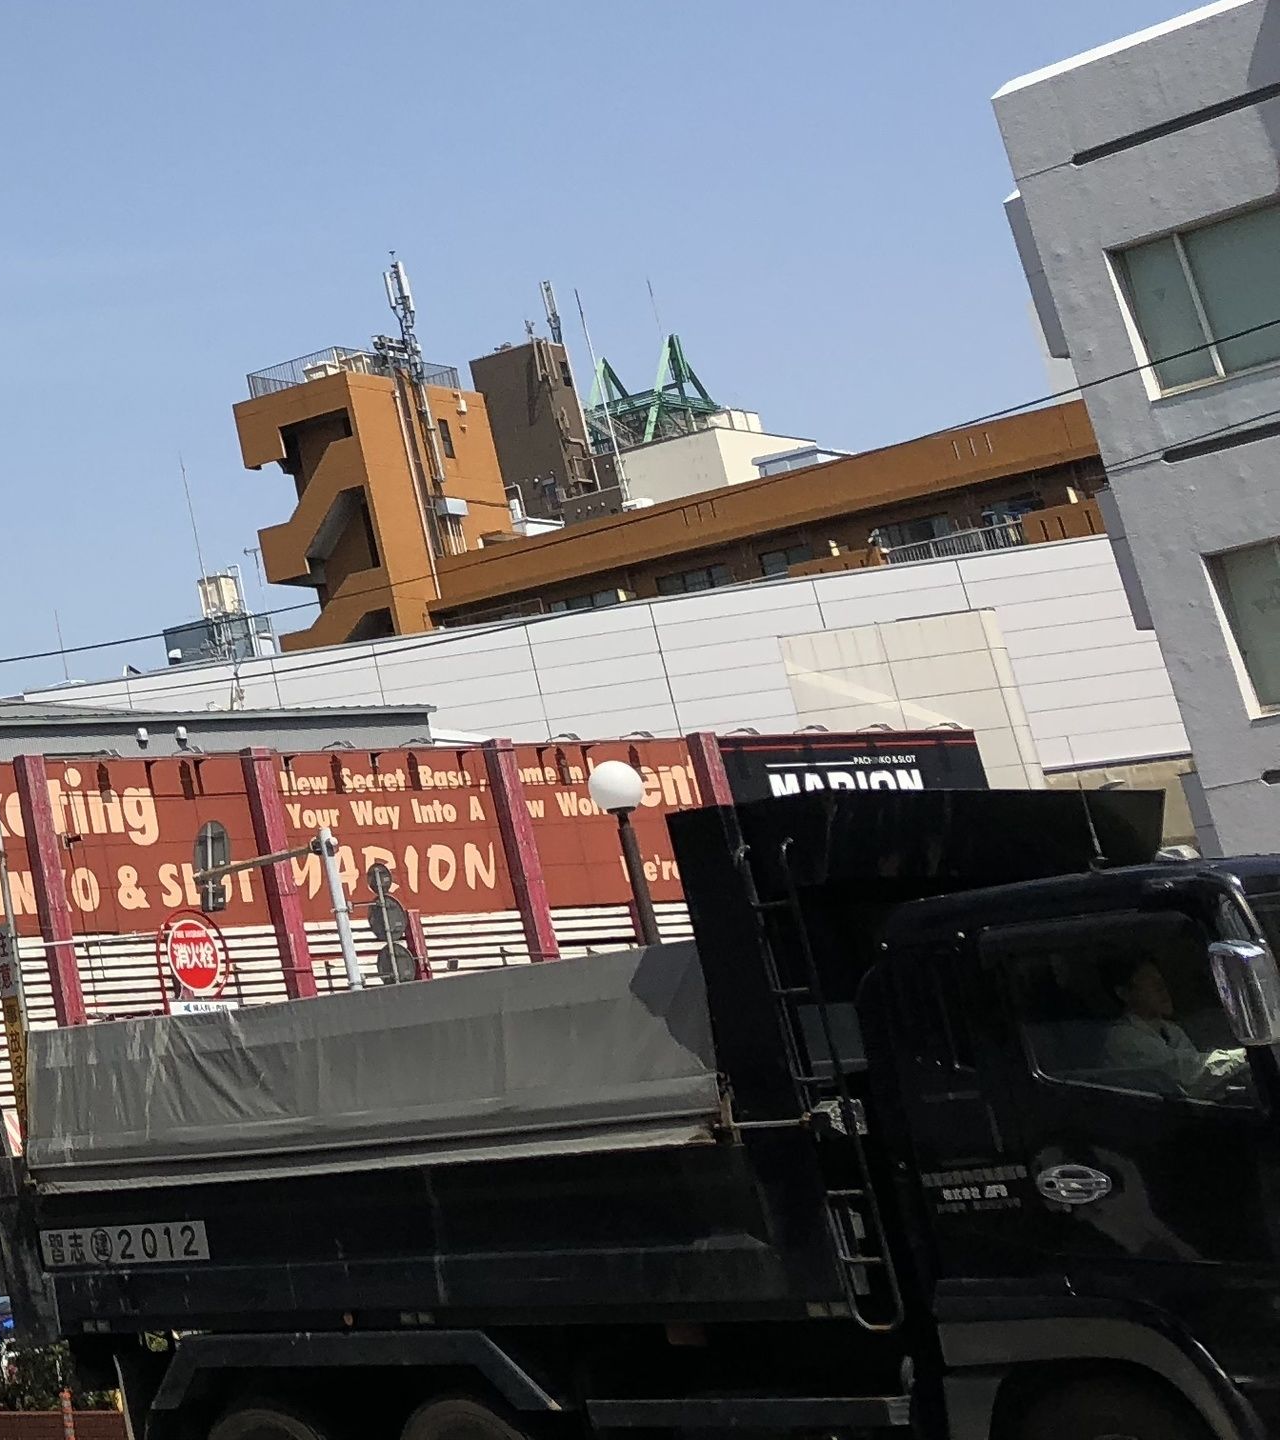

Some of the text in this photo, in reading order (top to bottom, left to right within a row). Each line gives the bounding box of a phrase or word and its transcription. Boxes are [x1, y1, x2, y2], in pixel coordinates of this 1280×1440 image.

[280, 771, 328, 796] New
[341, 767, 406, 793] Secret
[286, 803, 340, 830] Your
[350, 800, 400, 831] Way
[411, 798, 457, 824] Into
[469, 795, 486, 821] A
[118, 864, 151, 910] &
[172, 941, 216, 969] 消火栓
